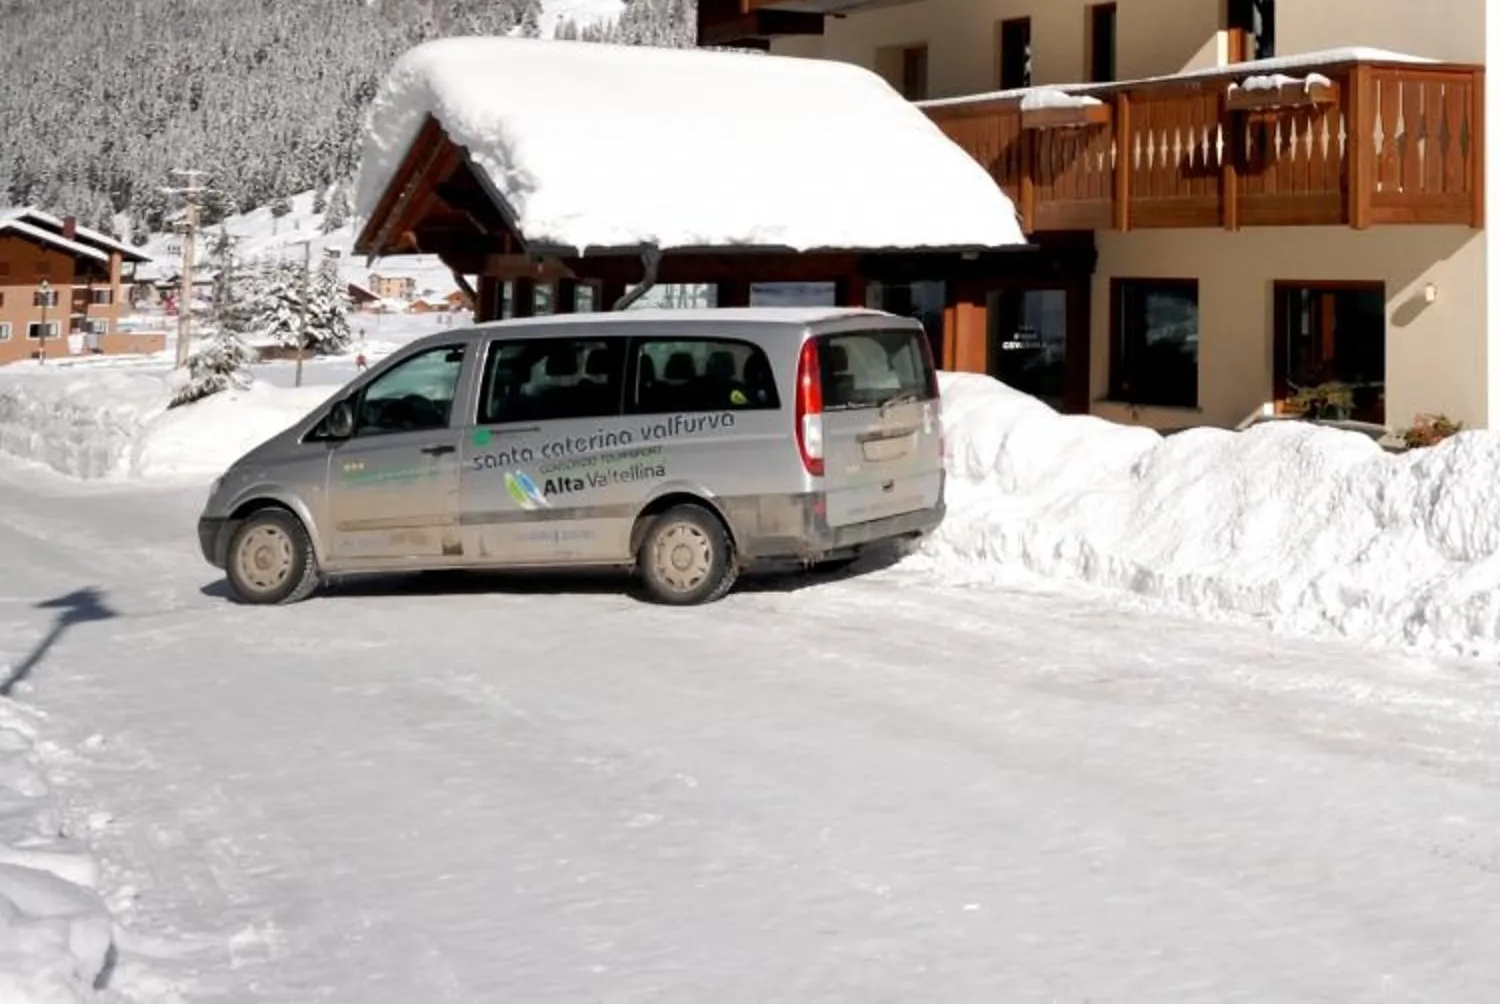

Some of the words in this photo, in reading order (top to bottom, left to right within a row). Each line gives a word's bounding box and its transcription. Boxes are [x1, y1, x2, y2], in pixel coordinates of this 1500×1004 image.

[473, 446, 533, 471] santa
[541, 428, 633, 458] caterina
[641, 412, 735, 441] valfurva
[543, 477, 585, 496] Alta
